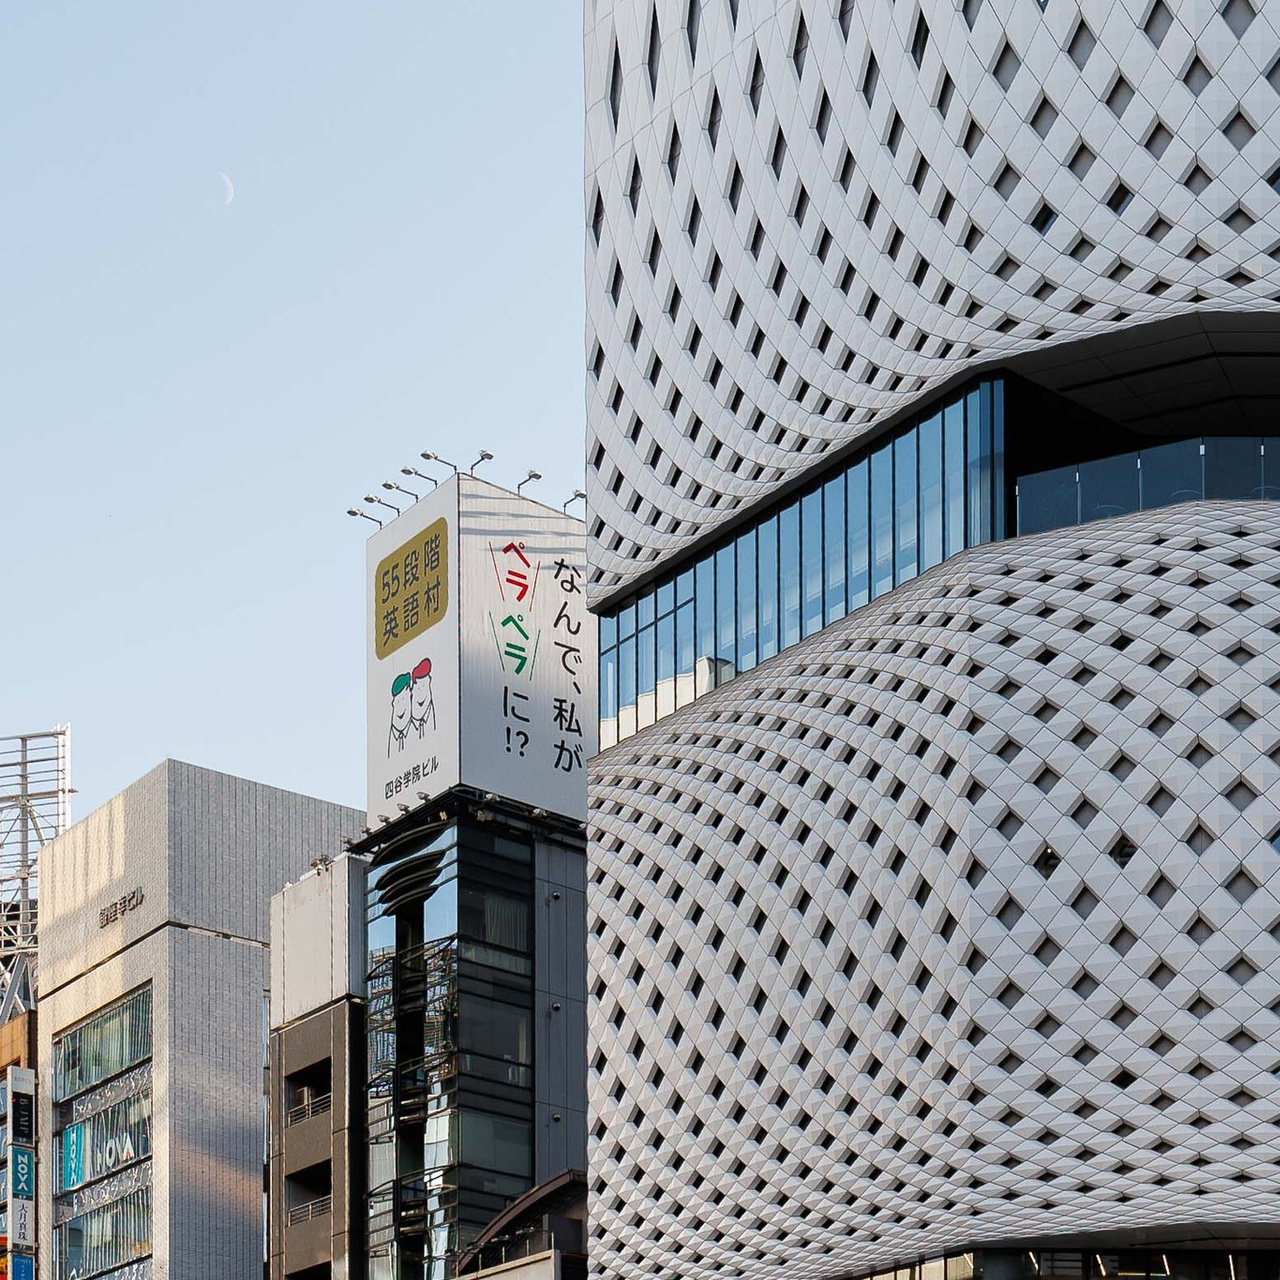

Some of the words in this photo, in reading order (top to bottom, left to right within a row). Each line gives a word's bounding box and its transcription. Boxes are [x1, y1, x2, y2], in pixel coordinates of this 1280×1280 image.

[381, 533, 441, 605] 55段階
[383, 575, 441, 647] 英語村
[553, 558, 583, 774] なんで、私が
[385, 756, 439, 799] 四谷学院ビル
[17, 1154, 29, 1191] NOVA
[17, 1203, 28, 1241] 大月真珠
